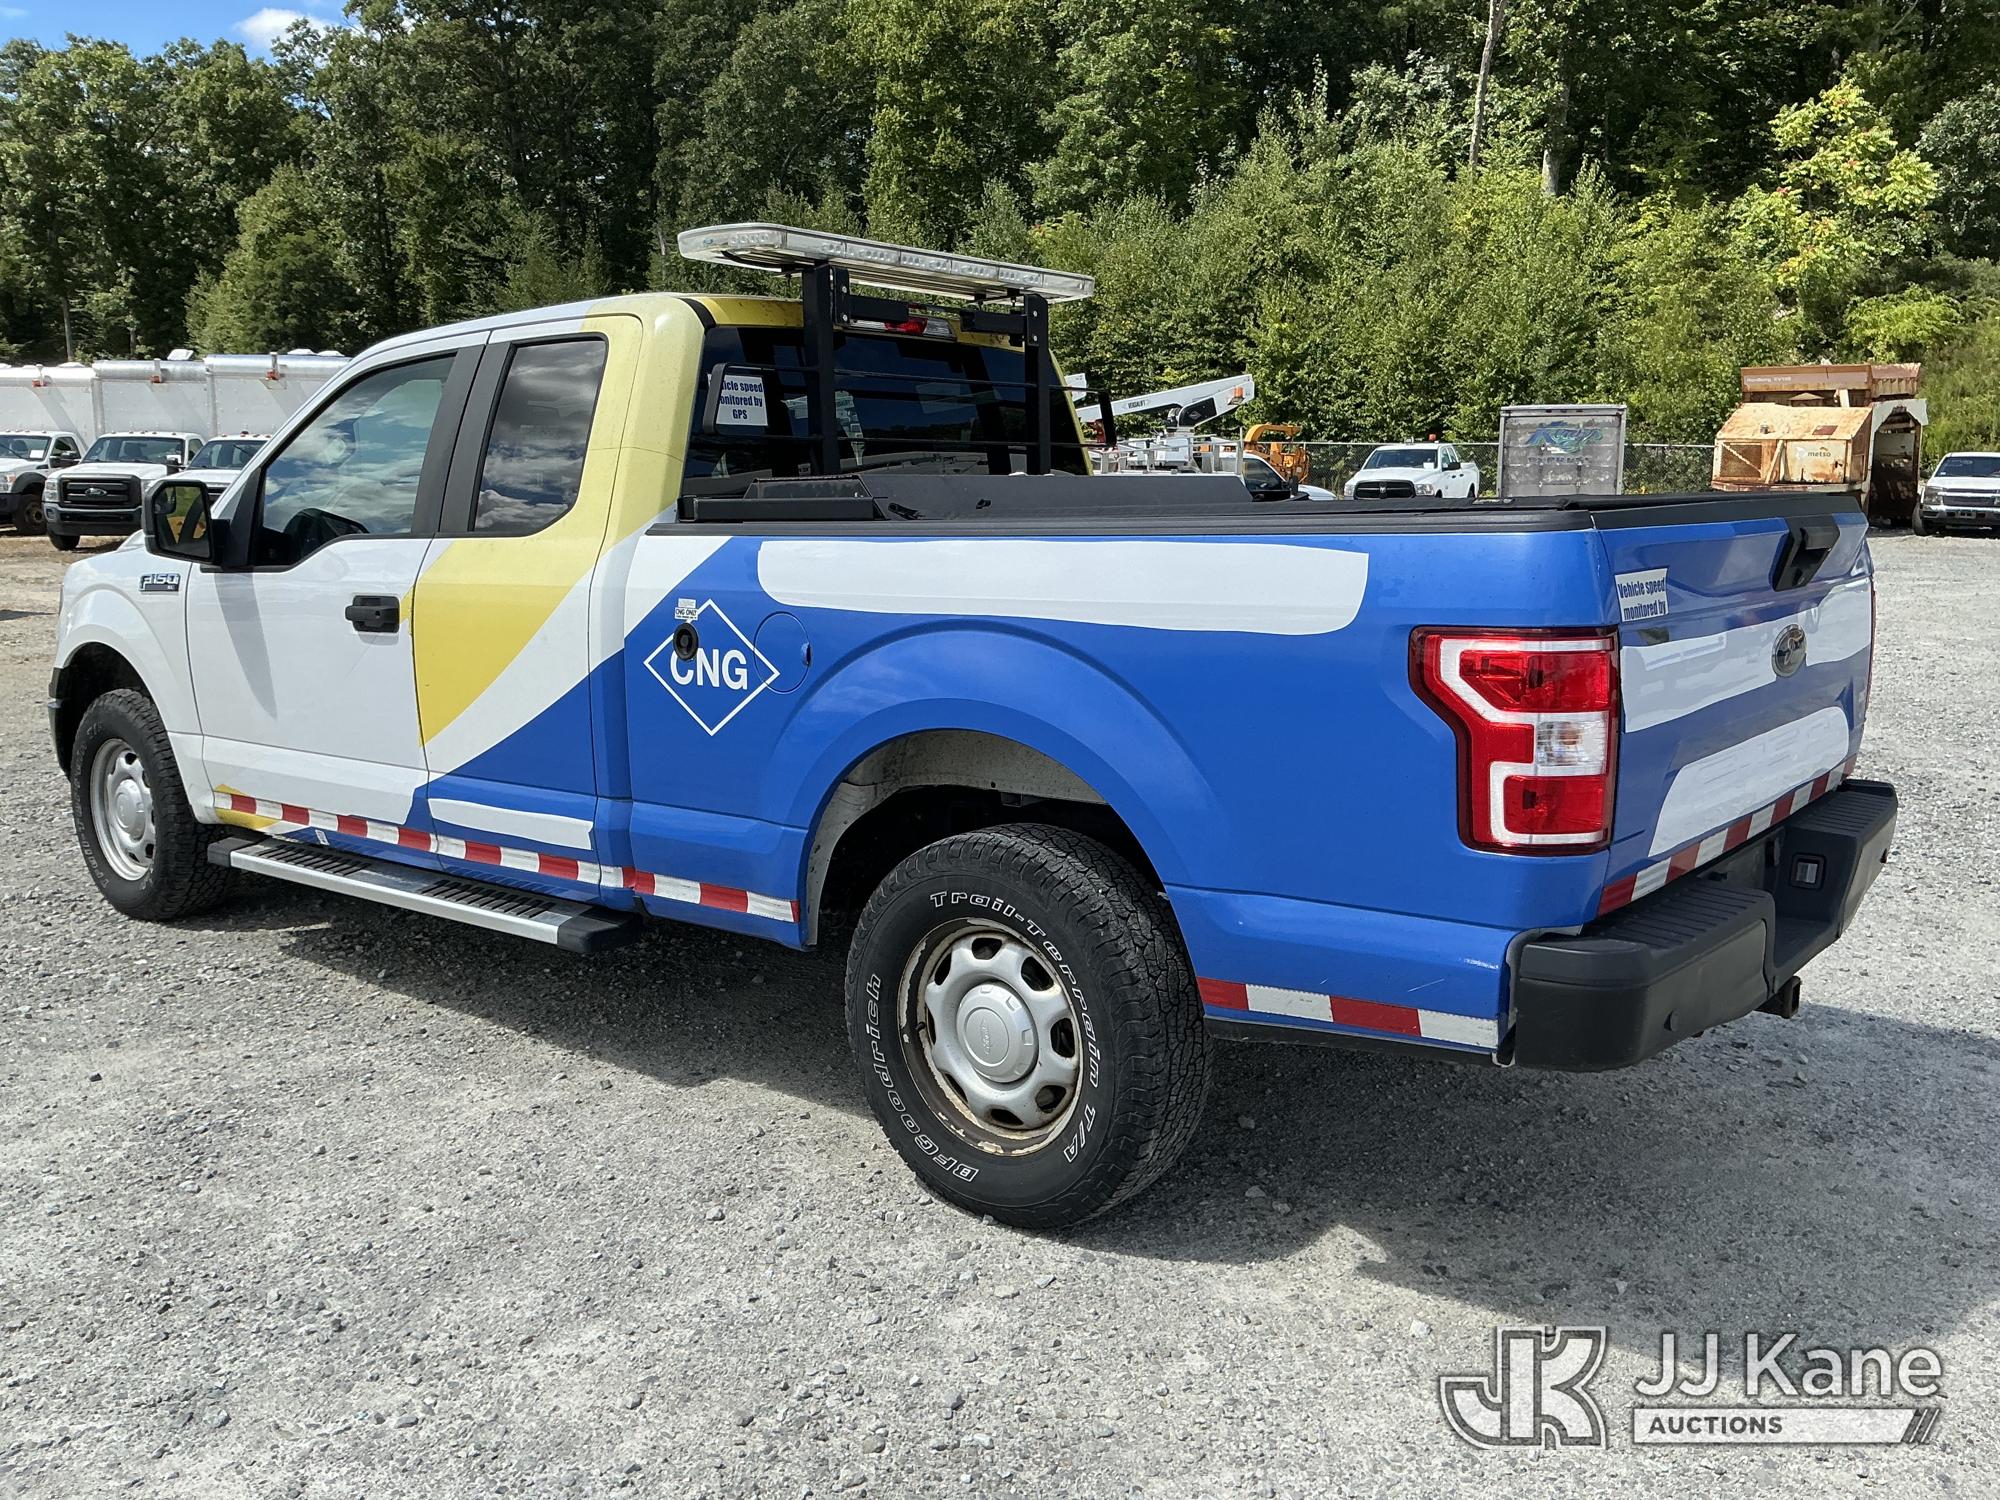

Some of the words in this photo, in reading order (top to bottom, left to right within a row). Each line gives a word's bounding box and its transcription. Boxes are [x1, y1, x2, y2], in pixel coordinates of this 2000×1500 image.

[723, 381, 738, 390] icle
[740, 382, 763, 392] speed
[721, 396, 753, 406] onitored
[754, 396, 763, 407] by
[732, 409, 748, 419] GPS
[1617, 581, 1645, 599] Vehicle
[1645, 577, 1665, 595] speed
[1623, 600, 1658, 621] monitored
[1658, 600, 1666, 616] by
[670, 648, 748, 690] CNG
[930, 889, 1101, 1089] Trail-Terrain
[1063, 1103, 1097, 1163] T/A
[866, 973, 980, 1182] BFGoodrich
